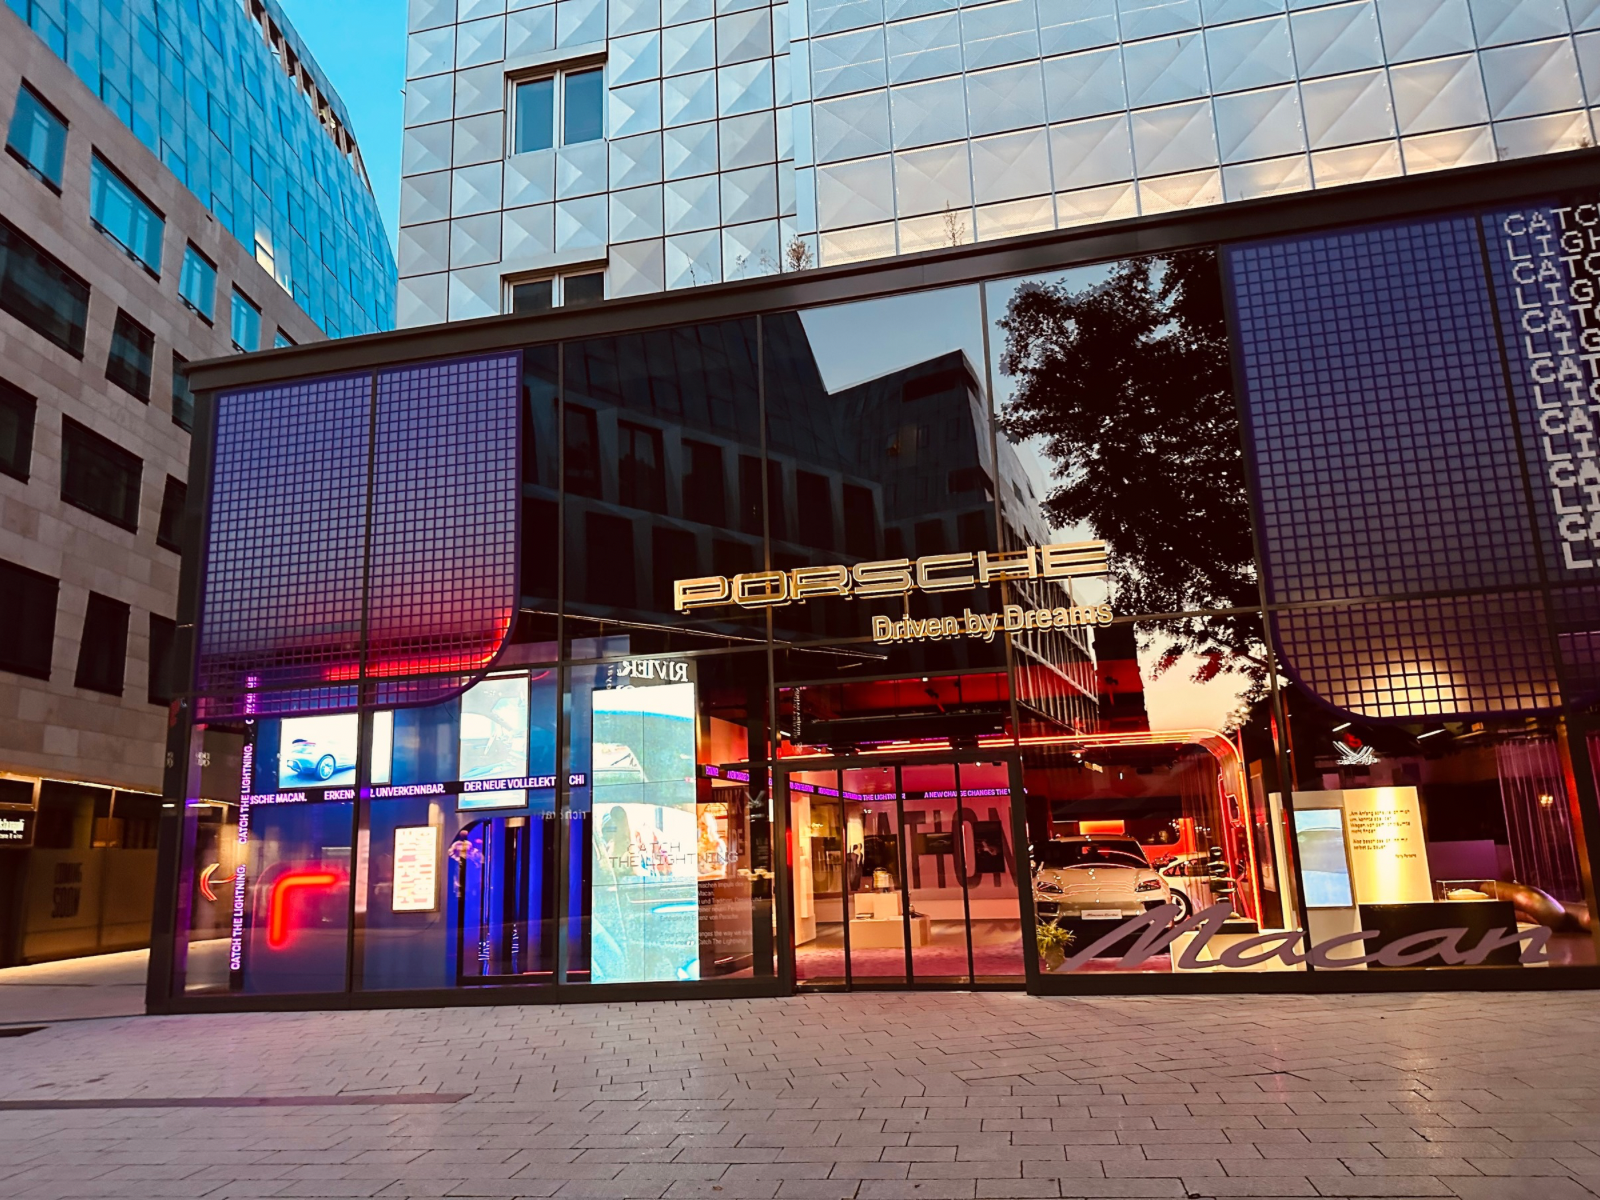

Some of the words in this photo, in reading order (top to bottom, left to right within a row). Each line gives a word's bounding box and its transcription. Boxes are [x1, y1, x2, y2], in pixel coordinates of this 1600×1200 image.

[1503, 203, 1600, 237] CATC
[1515, 276, 1600, 309] LIG
[674, 540, 1109, 613] PORSCHE
[872, 613, 960, 643] Driven
[964, 607, 999, 641] by
[1003, 603, 1114, 633] Dreams
[276, 792, 307, 803] MACAN.
[376, 783, 446, 798] UNVERKENNBAR.
[463, 780, 482, 792] DER
[483, 779, 506, 791] NEUE
[929, 790, 943, 798] NEW
[240, 794, 250, 814] THE
[238, 815, 249, 845] CATCH
[232, 917, 243, 938] THE
[1054, 902, 1555, 973] Macan
[230, 938, 242, 970] CATCH
